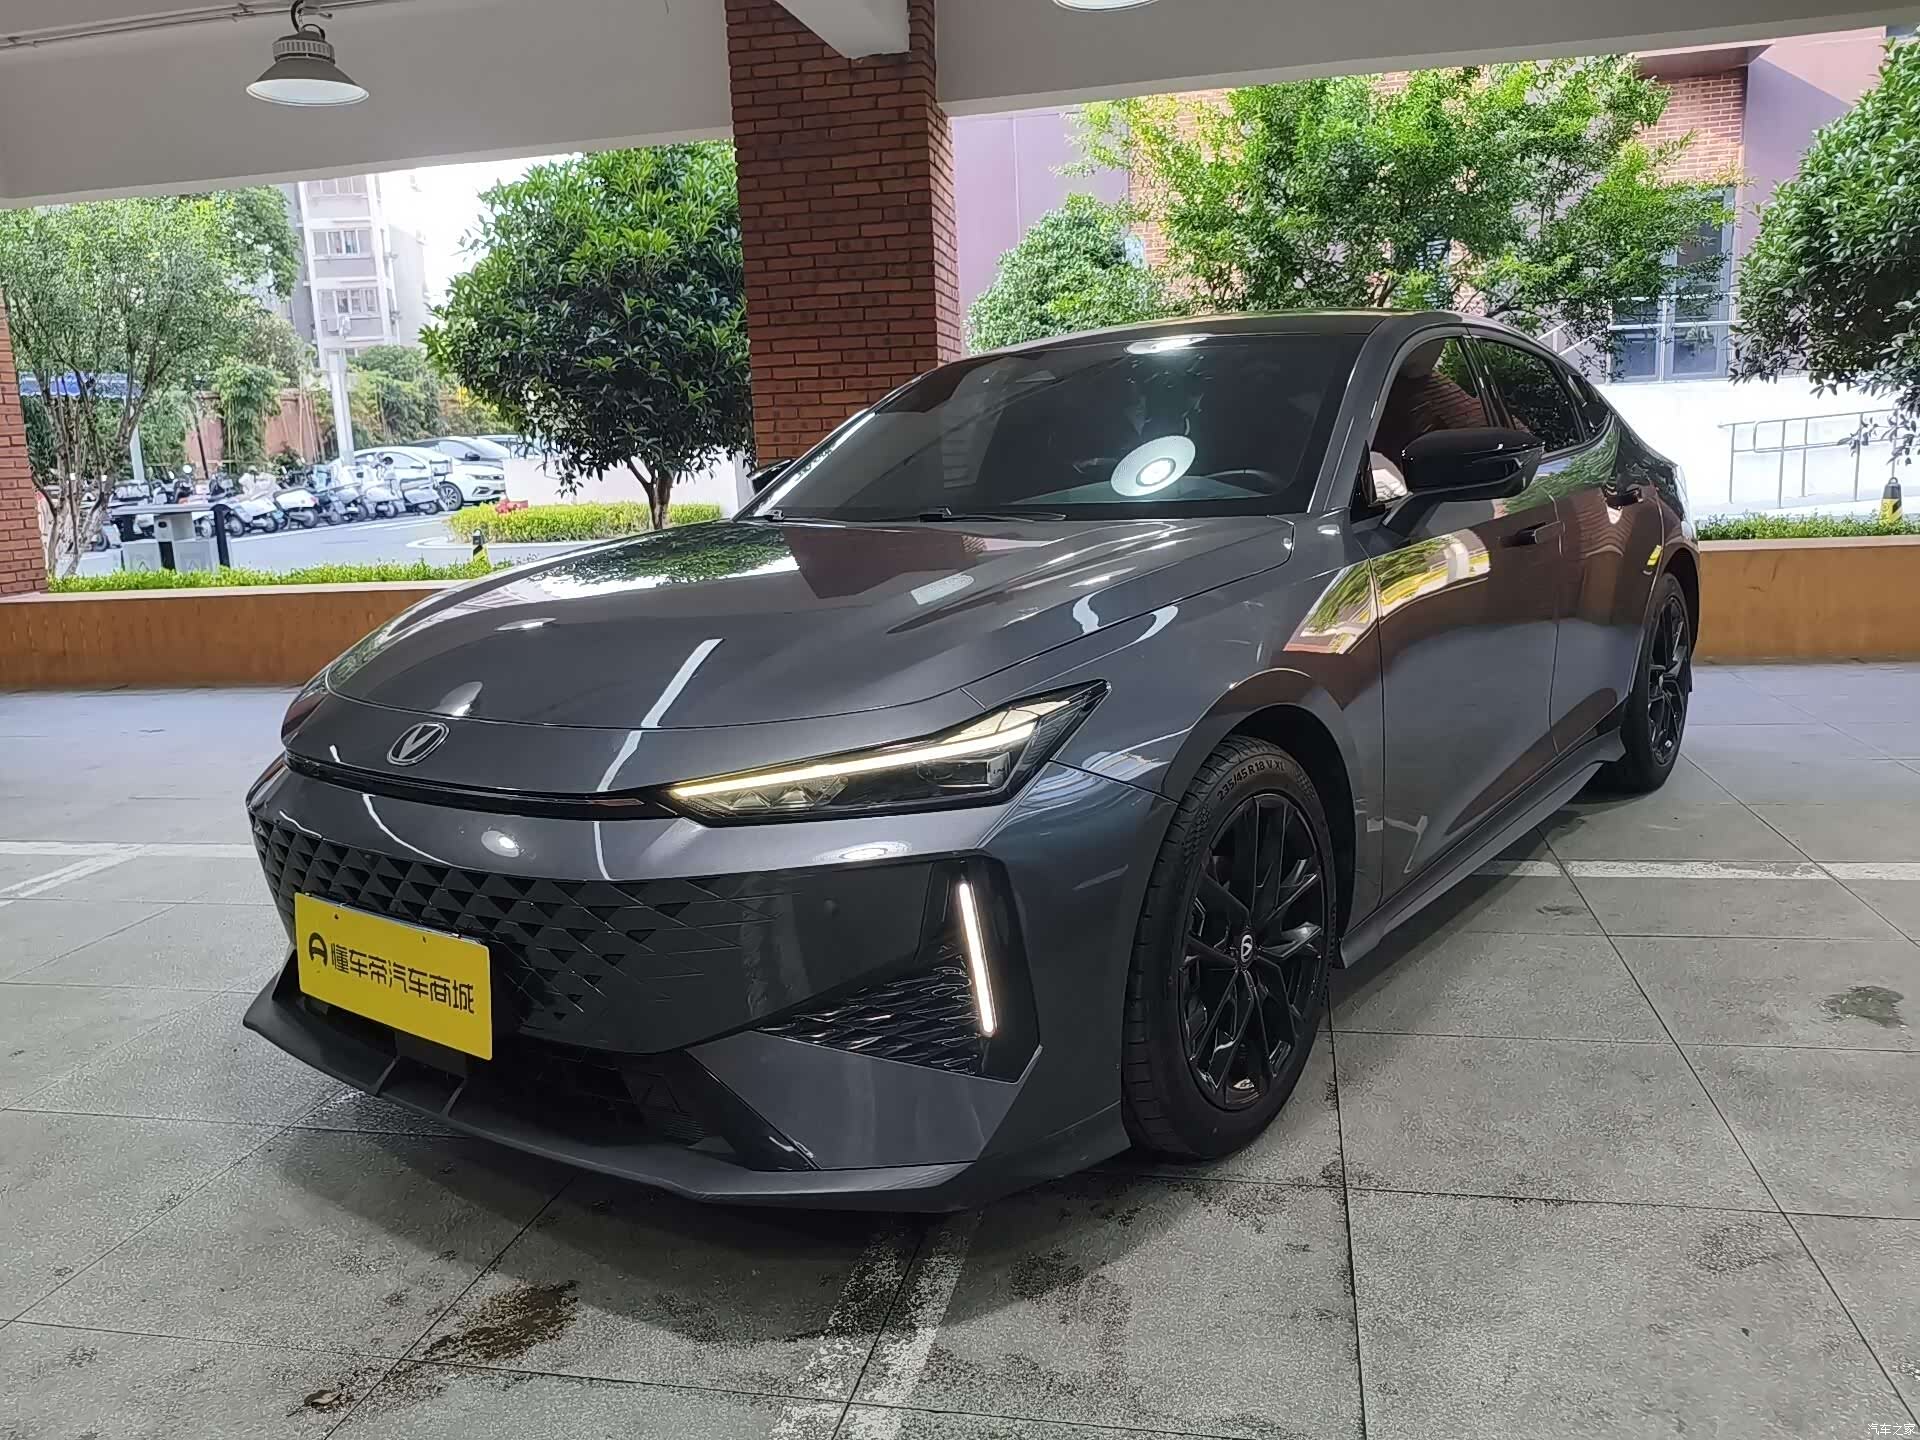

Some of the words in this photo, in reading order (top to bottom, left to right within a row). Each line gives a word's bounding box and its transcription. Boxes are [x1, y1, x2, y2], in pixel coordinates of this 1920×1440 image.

[1216, 767, 1249, 801] 235/45
[331, 943, 475, 1014] 懂车帝汽车商城
